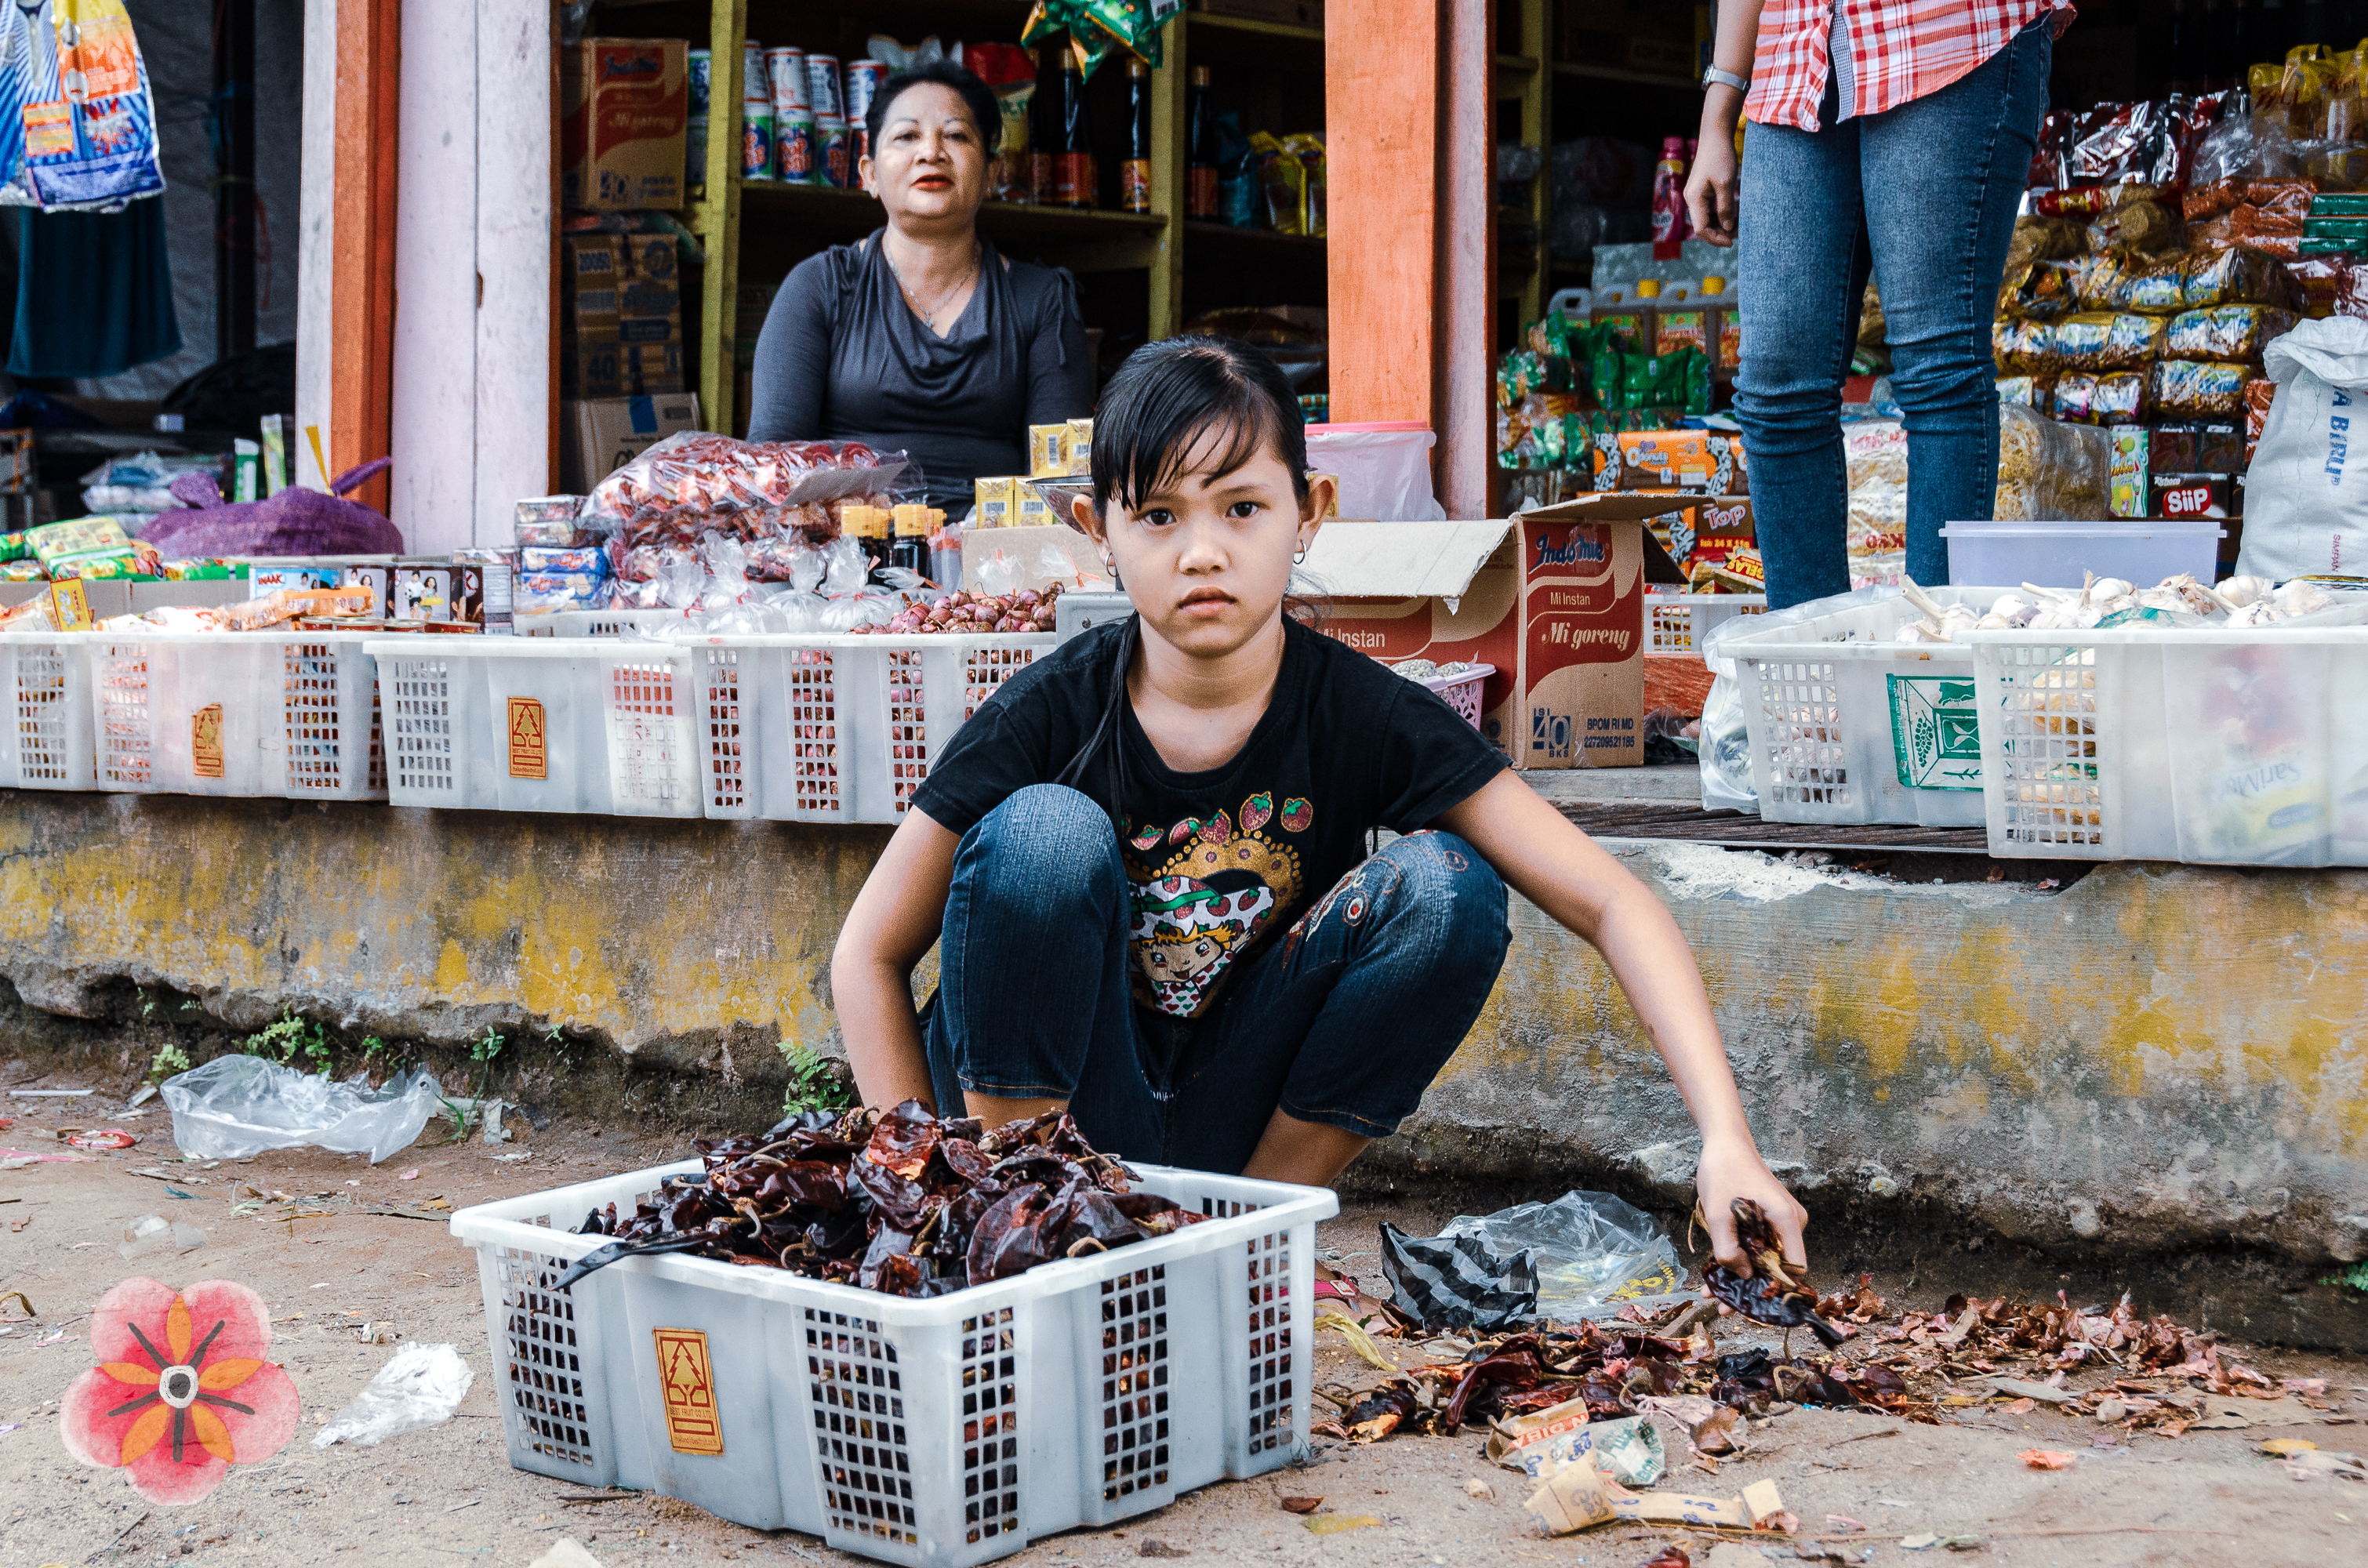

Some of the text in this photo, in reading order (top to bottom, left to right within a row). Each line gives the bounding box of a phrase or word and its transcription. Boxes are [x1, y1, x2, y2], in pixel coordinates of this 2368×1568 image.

[2167, 488, 2208, 514] SiiP
[2332, 534, 2341, 572] SIMPAN
[1550, 592, 1590, 605] Mi Instan
[1338, 628, 1386, 648] Instan
[1542, 622, 1630, 652] Mi goreng
[1533, 707, 1550, 717] ISI
[1586, 717, 1634, 730] BPOM RI MD
[1532, 715, 1572, 750] 40
[1584, 735, 1635, 748] 227209521185
[1549, 750, 1569, 758] BKS
